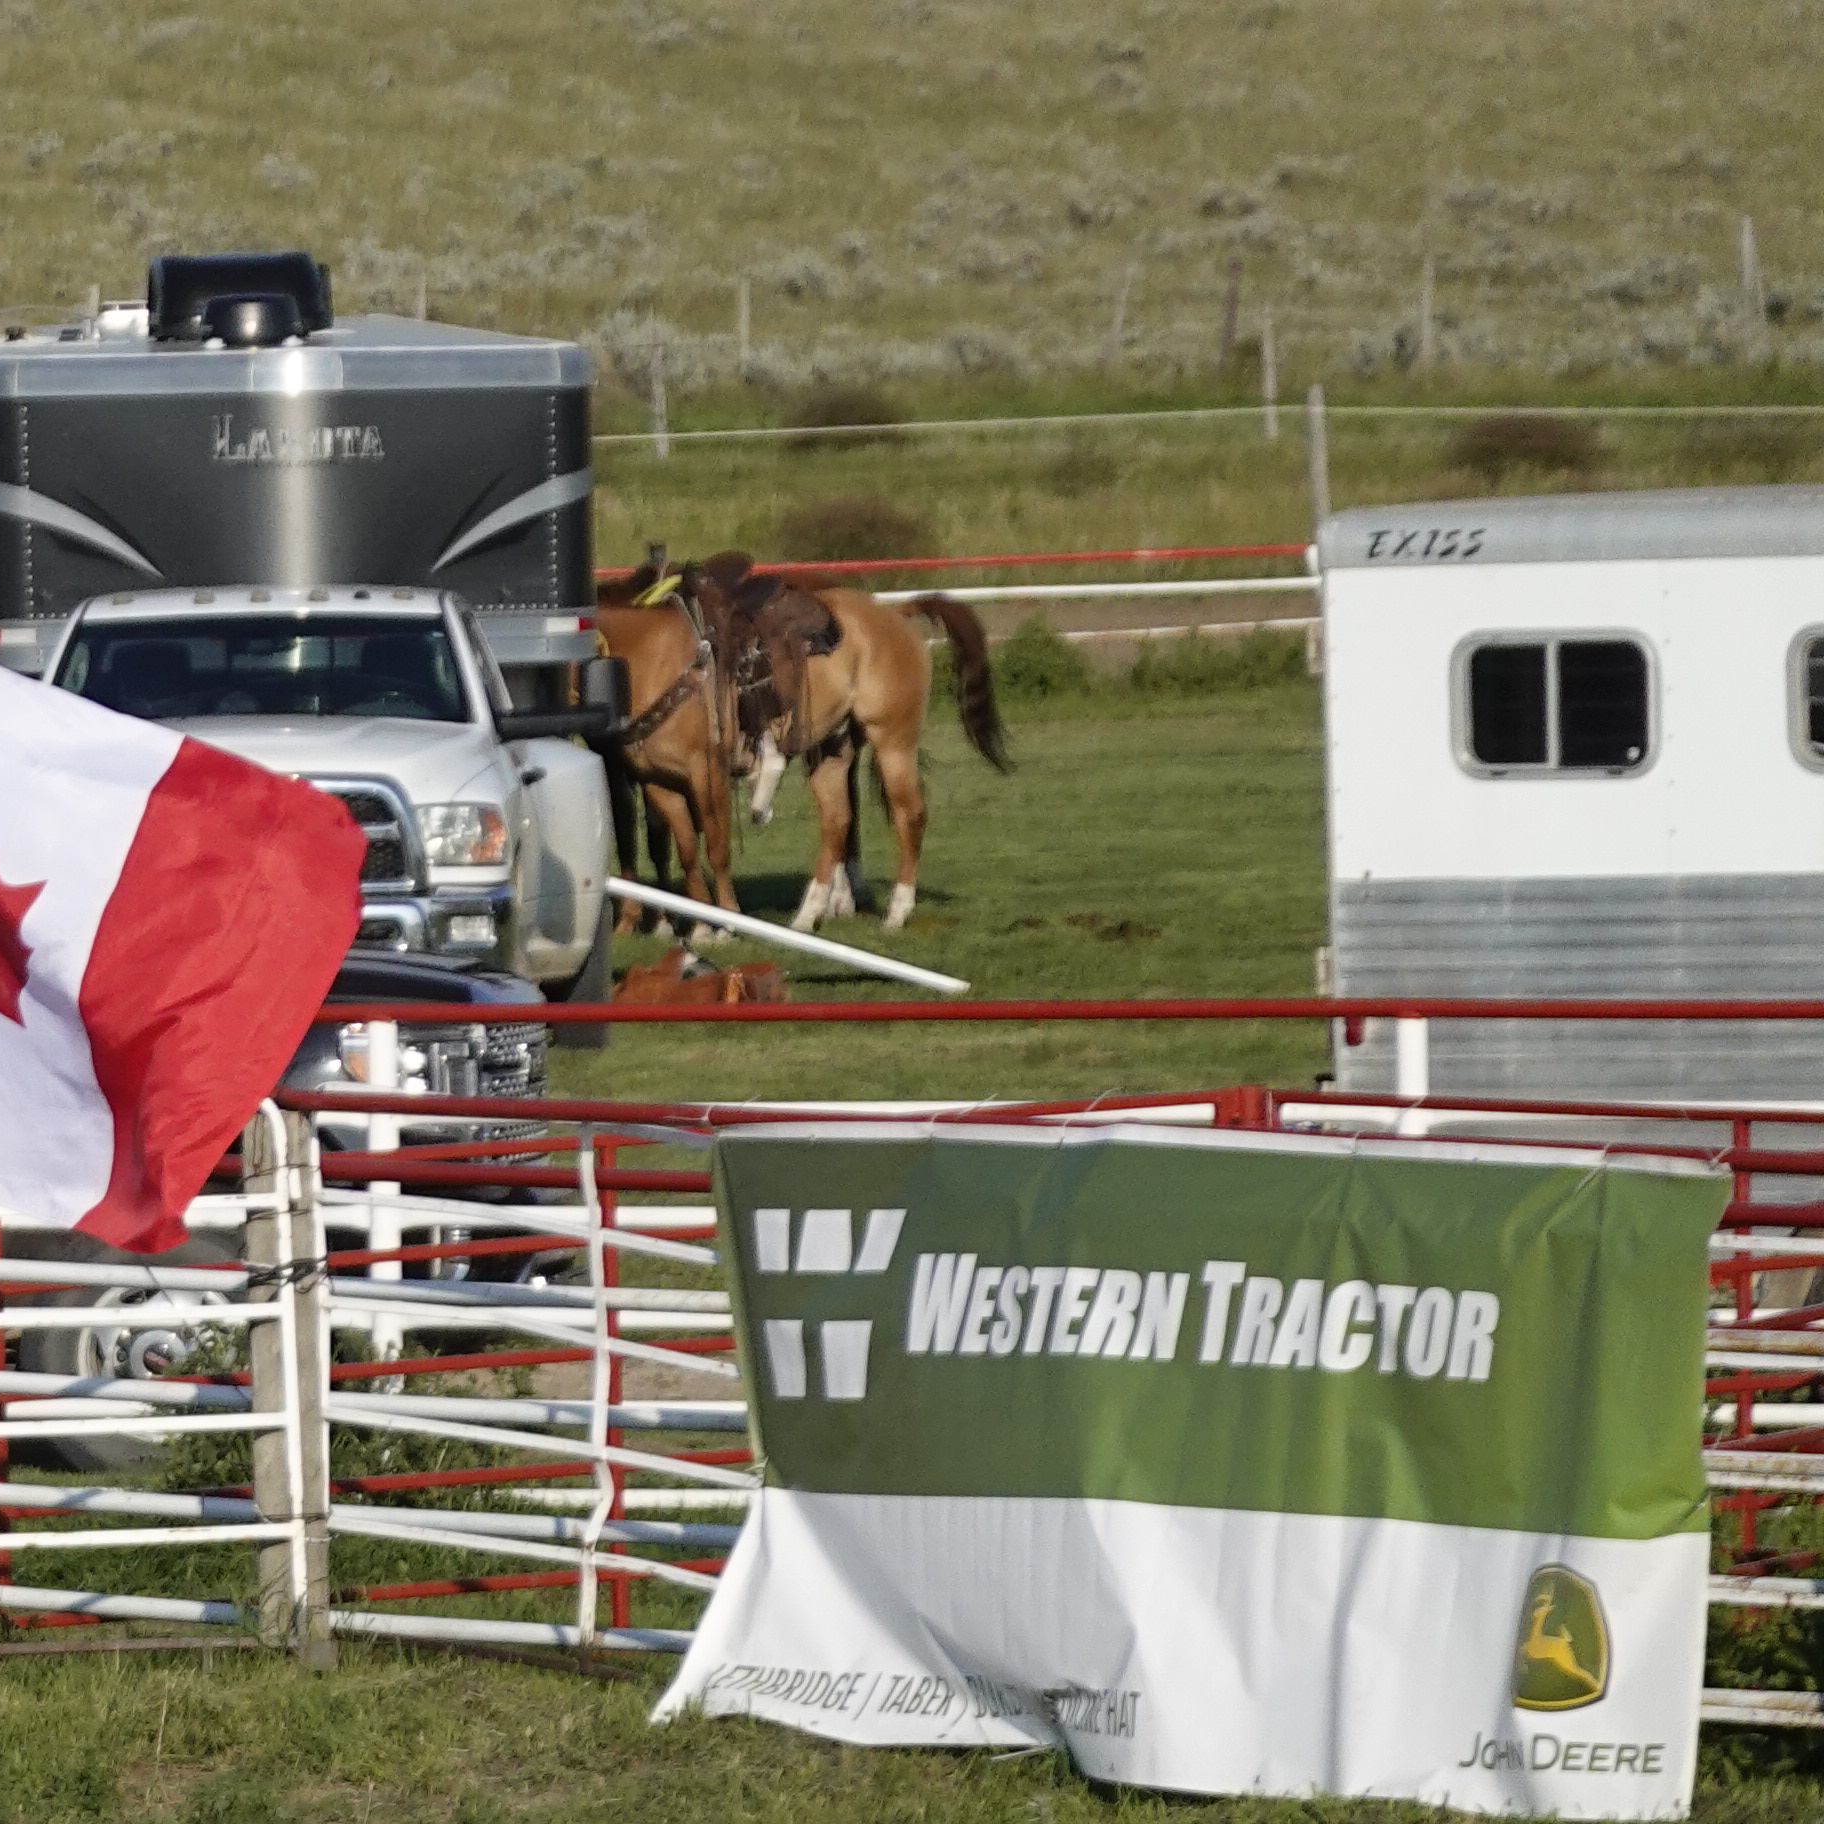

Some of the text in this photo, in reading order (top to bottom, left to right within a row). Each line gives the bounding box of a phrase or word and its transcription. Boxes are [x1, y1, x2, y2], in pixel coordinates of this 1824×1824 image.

[212, 413, 386, 460] LAOTA
[904, 1251, 1502, 1386] WESTERN TRACTOR
[1457, 1730, 1669, 1774] JOHN DEERE
